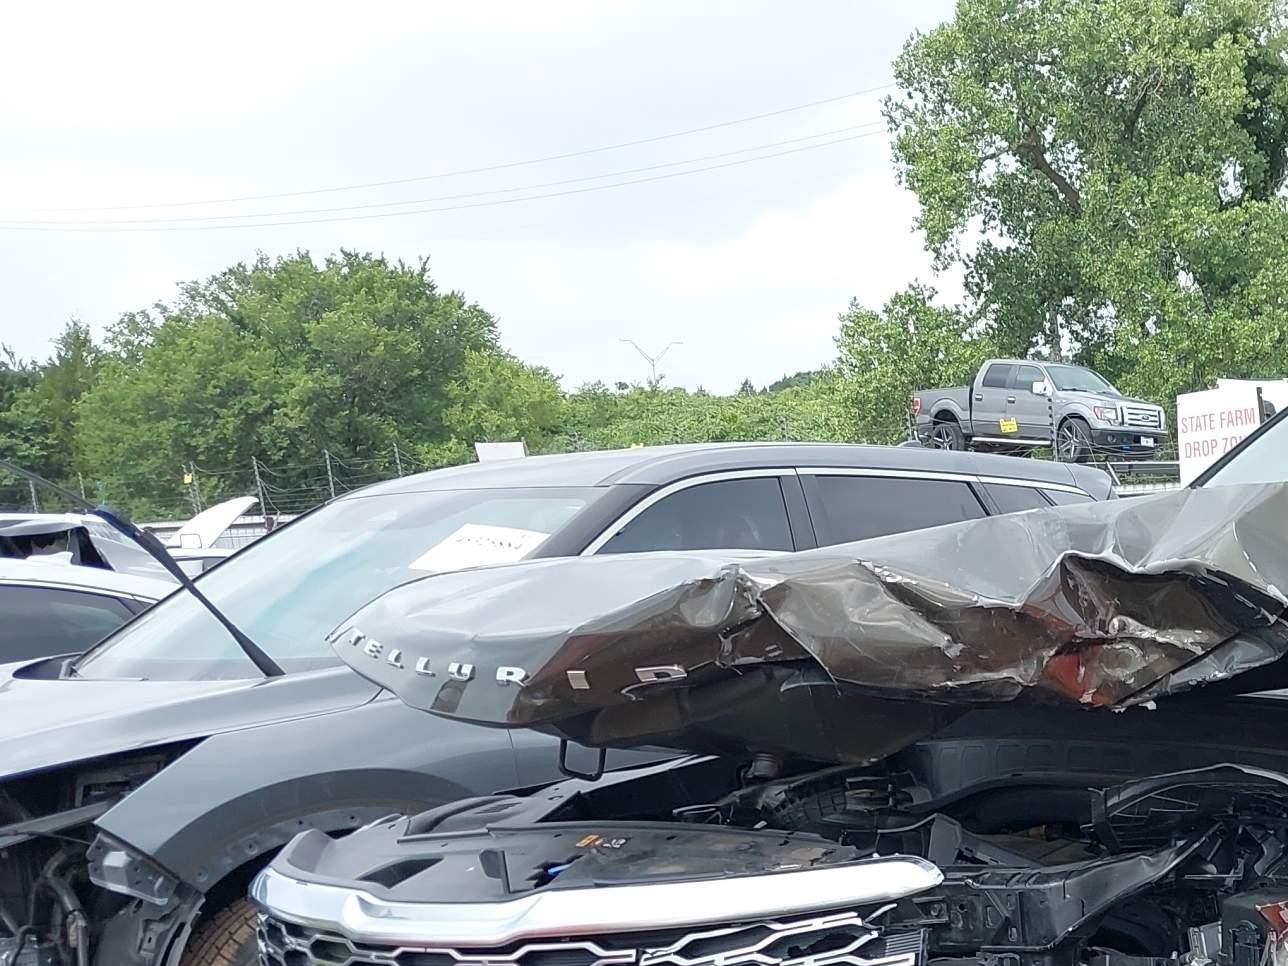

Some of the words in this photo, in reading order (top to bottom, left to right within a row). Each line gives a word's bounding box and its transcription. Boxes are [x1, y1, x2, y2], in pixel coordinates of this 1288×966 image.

[1182, 413, 1215, 433] STATE
[1220, 408, 1255, 428] FARM
[1185, 439, 1217, 458] DROP
[1222, 435, 1247, 453] ZO
